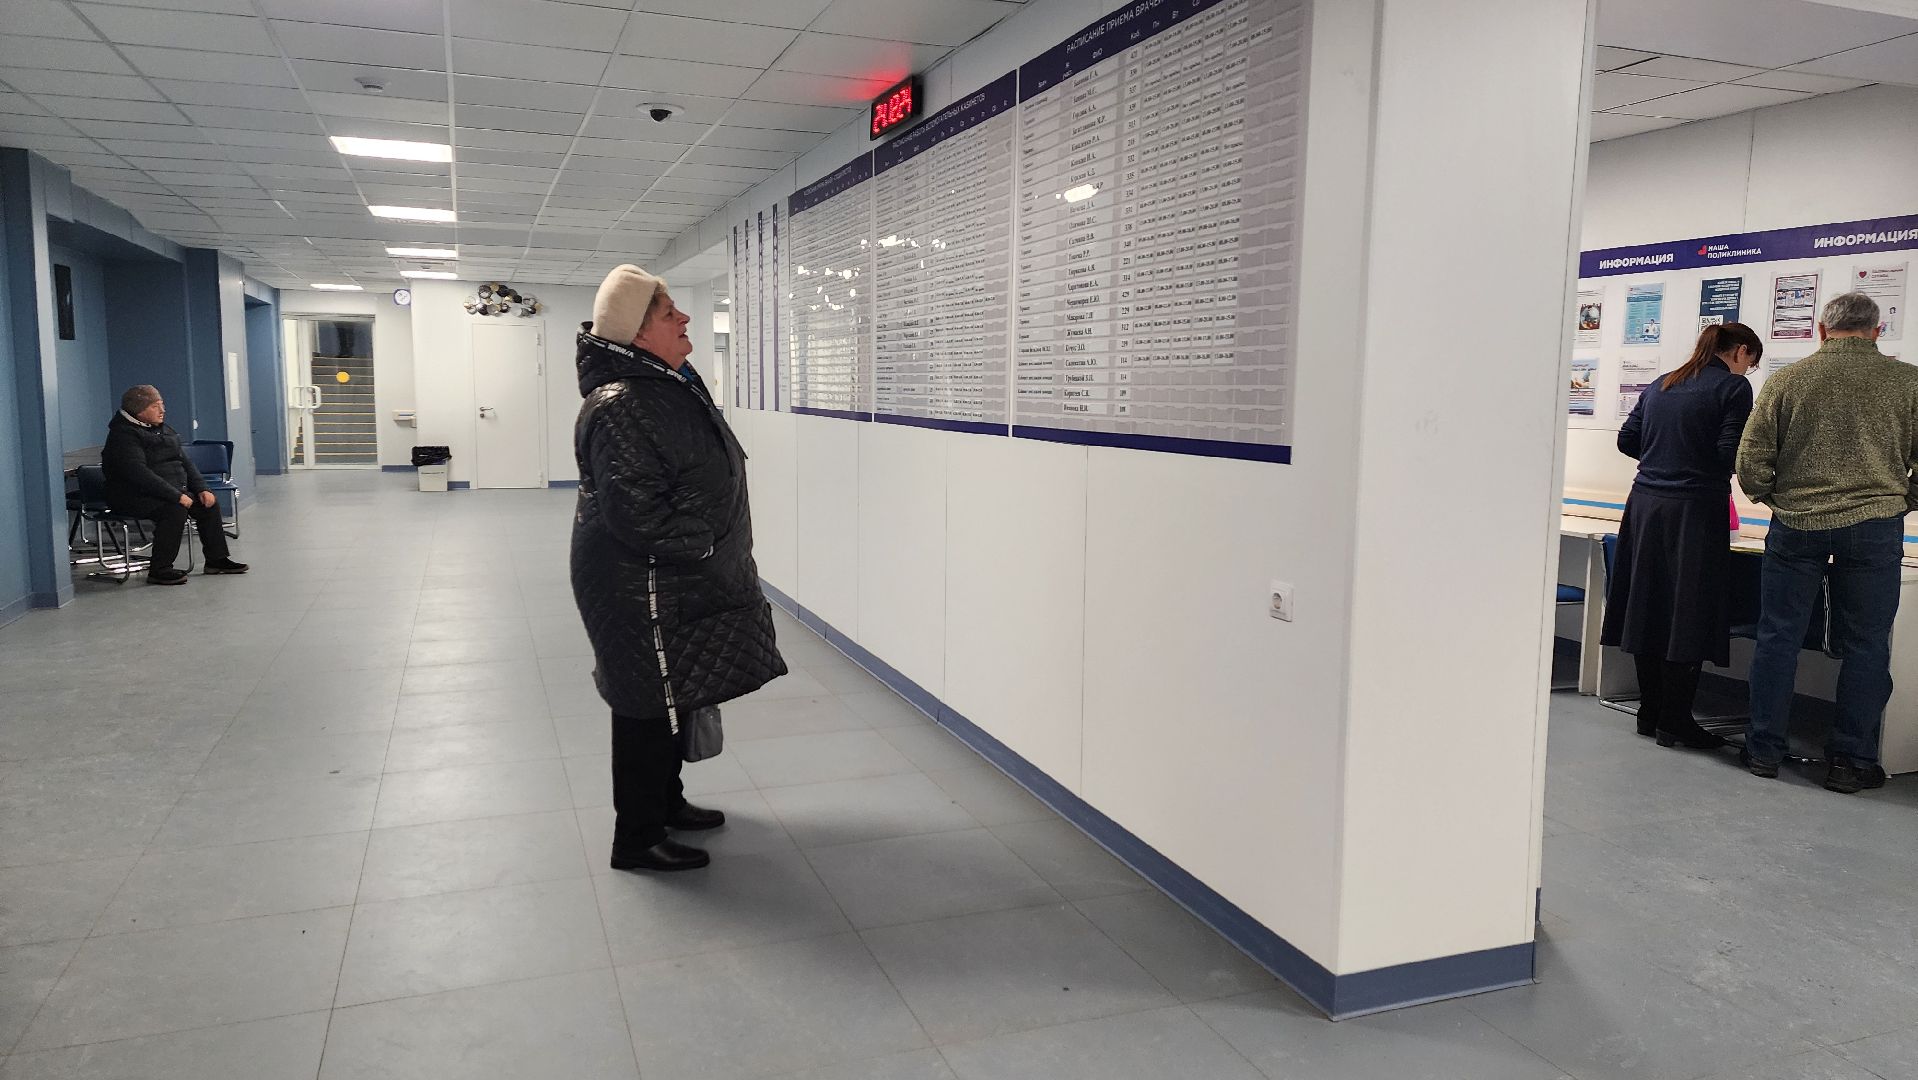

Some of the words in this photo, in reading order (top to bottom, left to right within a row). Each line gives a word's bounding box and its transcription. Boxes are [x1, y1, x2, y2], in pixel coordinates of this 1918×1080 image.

[1066, 24, 1106, 54] РАСПИСАНИЕ
[1106, 9, 1134, 32] ПРИЕМА
[1814, 228, 1918, 248] ИНФОРМАЦИЯ
[1599, 253, 1674, 270] ИНФОРМАЦИЯ
[1707, 248, 1762, 259] ПОЛИКЛИНИКА
